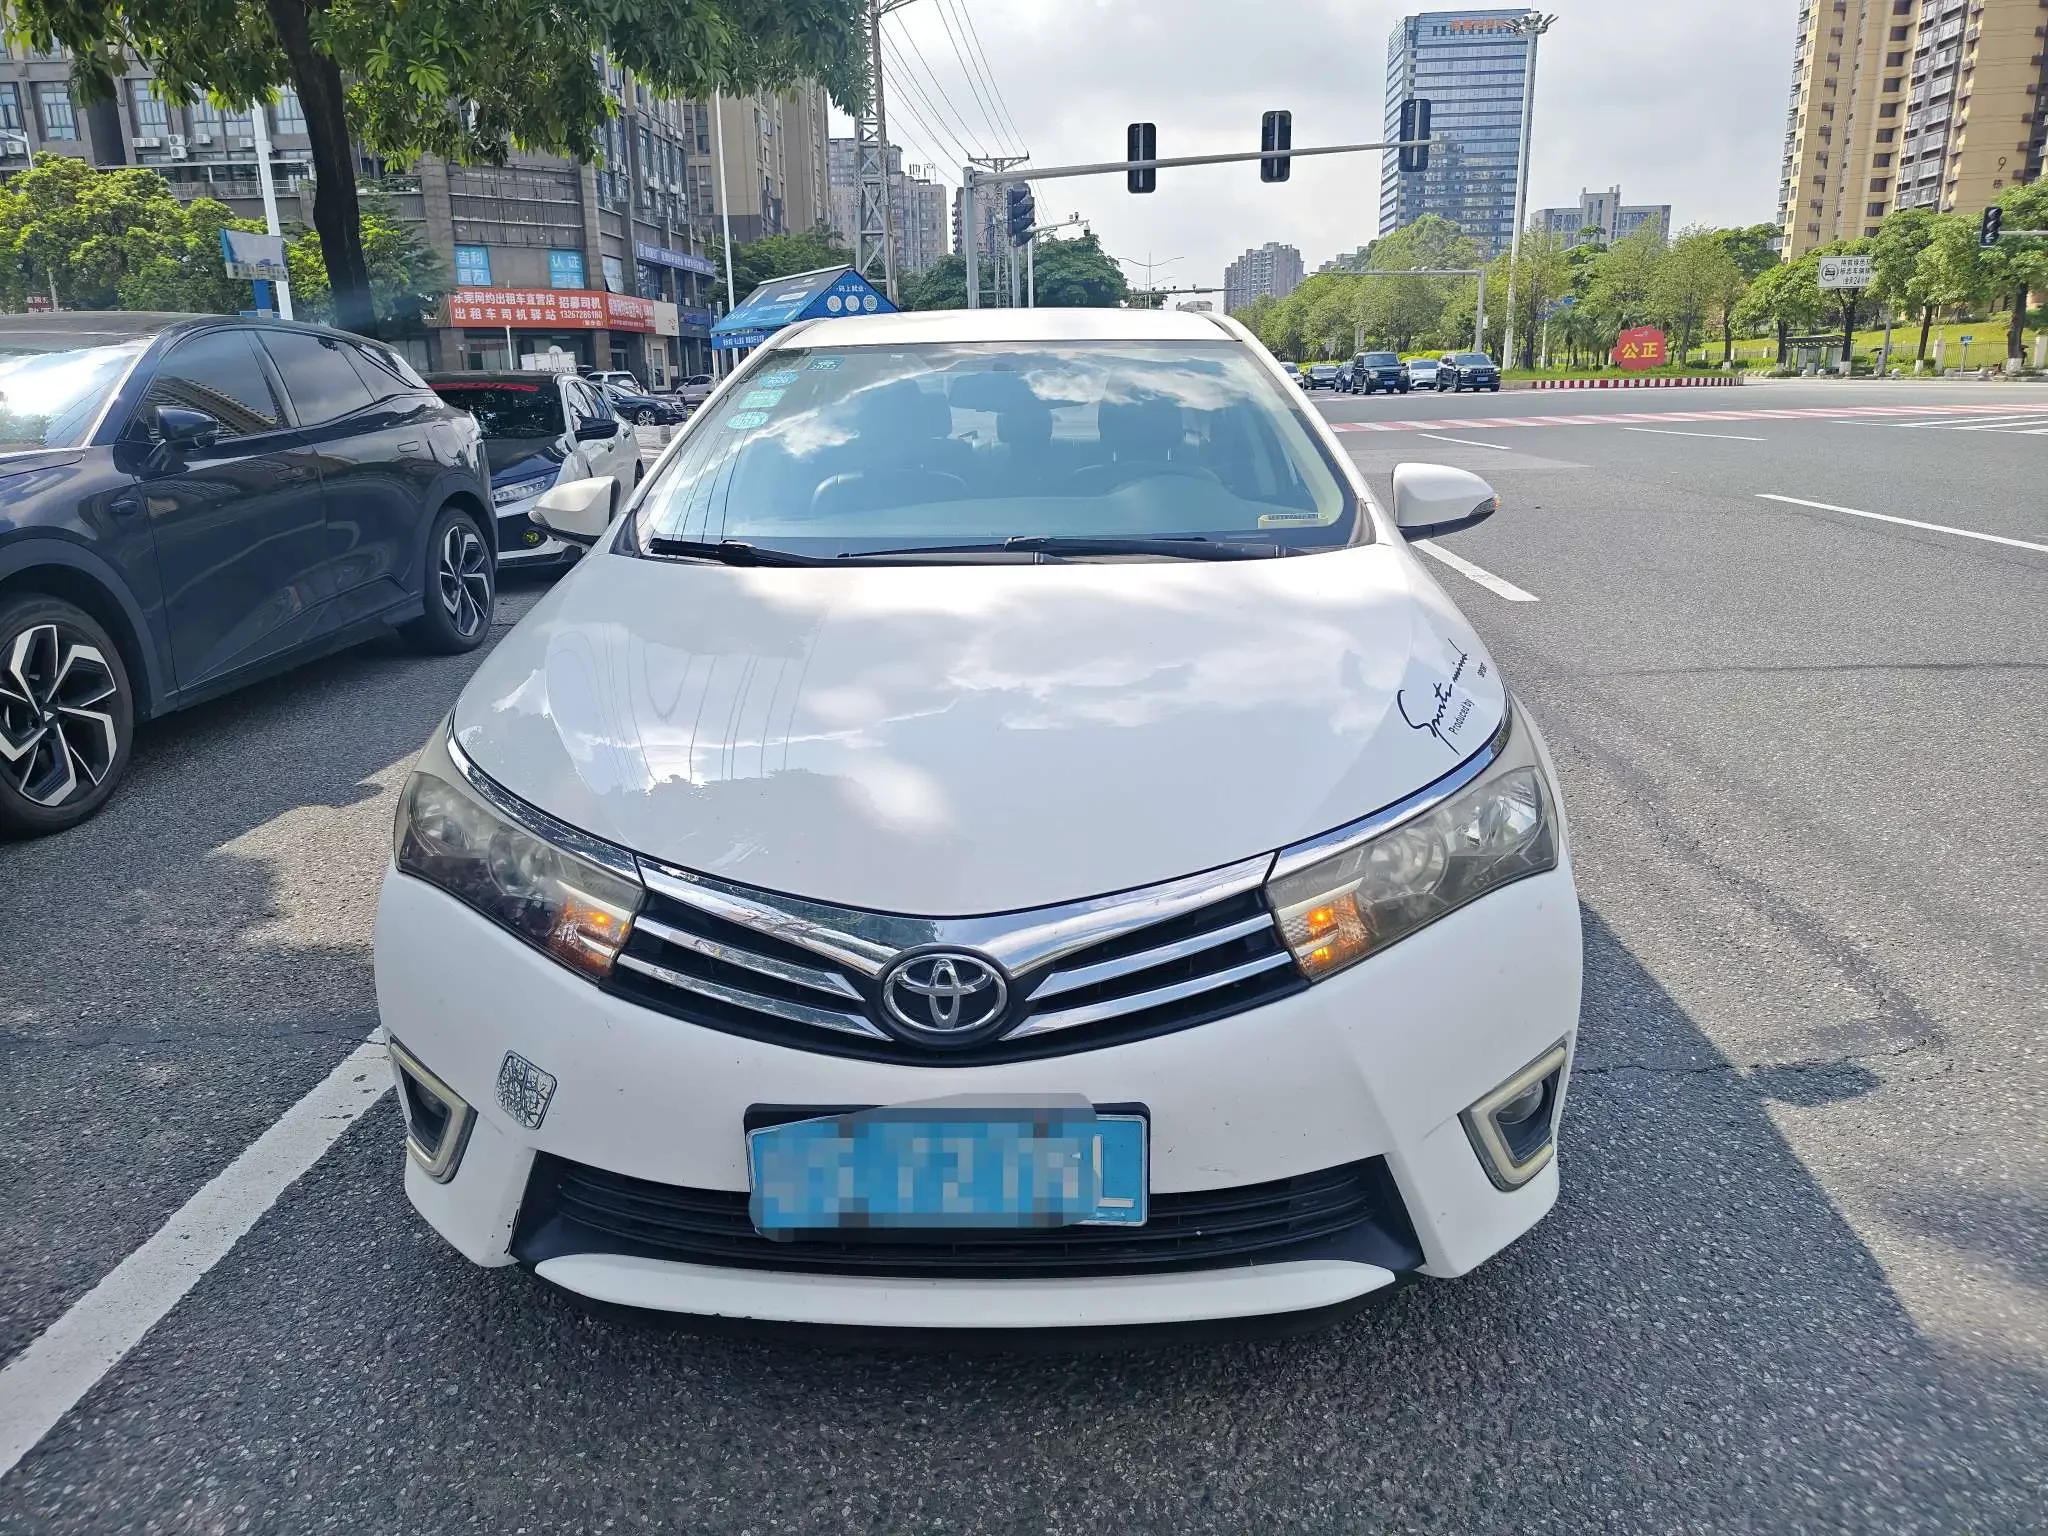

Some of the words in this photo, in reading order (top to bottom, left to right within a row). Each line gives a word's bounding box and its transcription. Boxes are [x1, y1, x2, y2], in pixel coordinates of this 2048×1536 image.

[1998, 156, 2007, 172] 9
[457, 251, 483, 265] 吉利
[552, 255, 580, 269] 认证
[454, 291, 556, 306] 东莞网约出租车直营店
[558, 296, 602, 310] 招募司机
[455, 307, 557, 321] 出租车司机驿站
[1622, 342, 1659, 359] 公正
[1448, 706, 1470, 735] Produced
